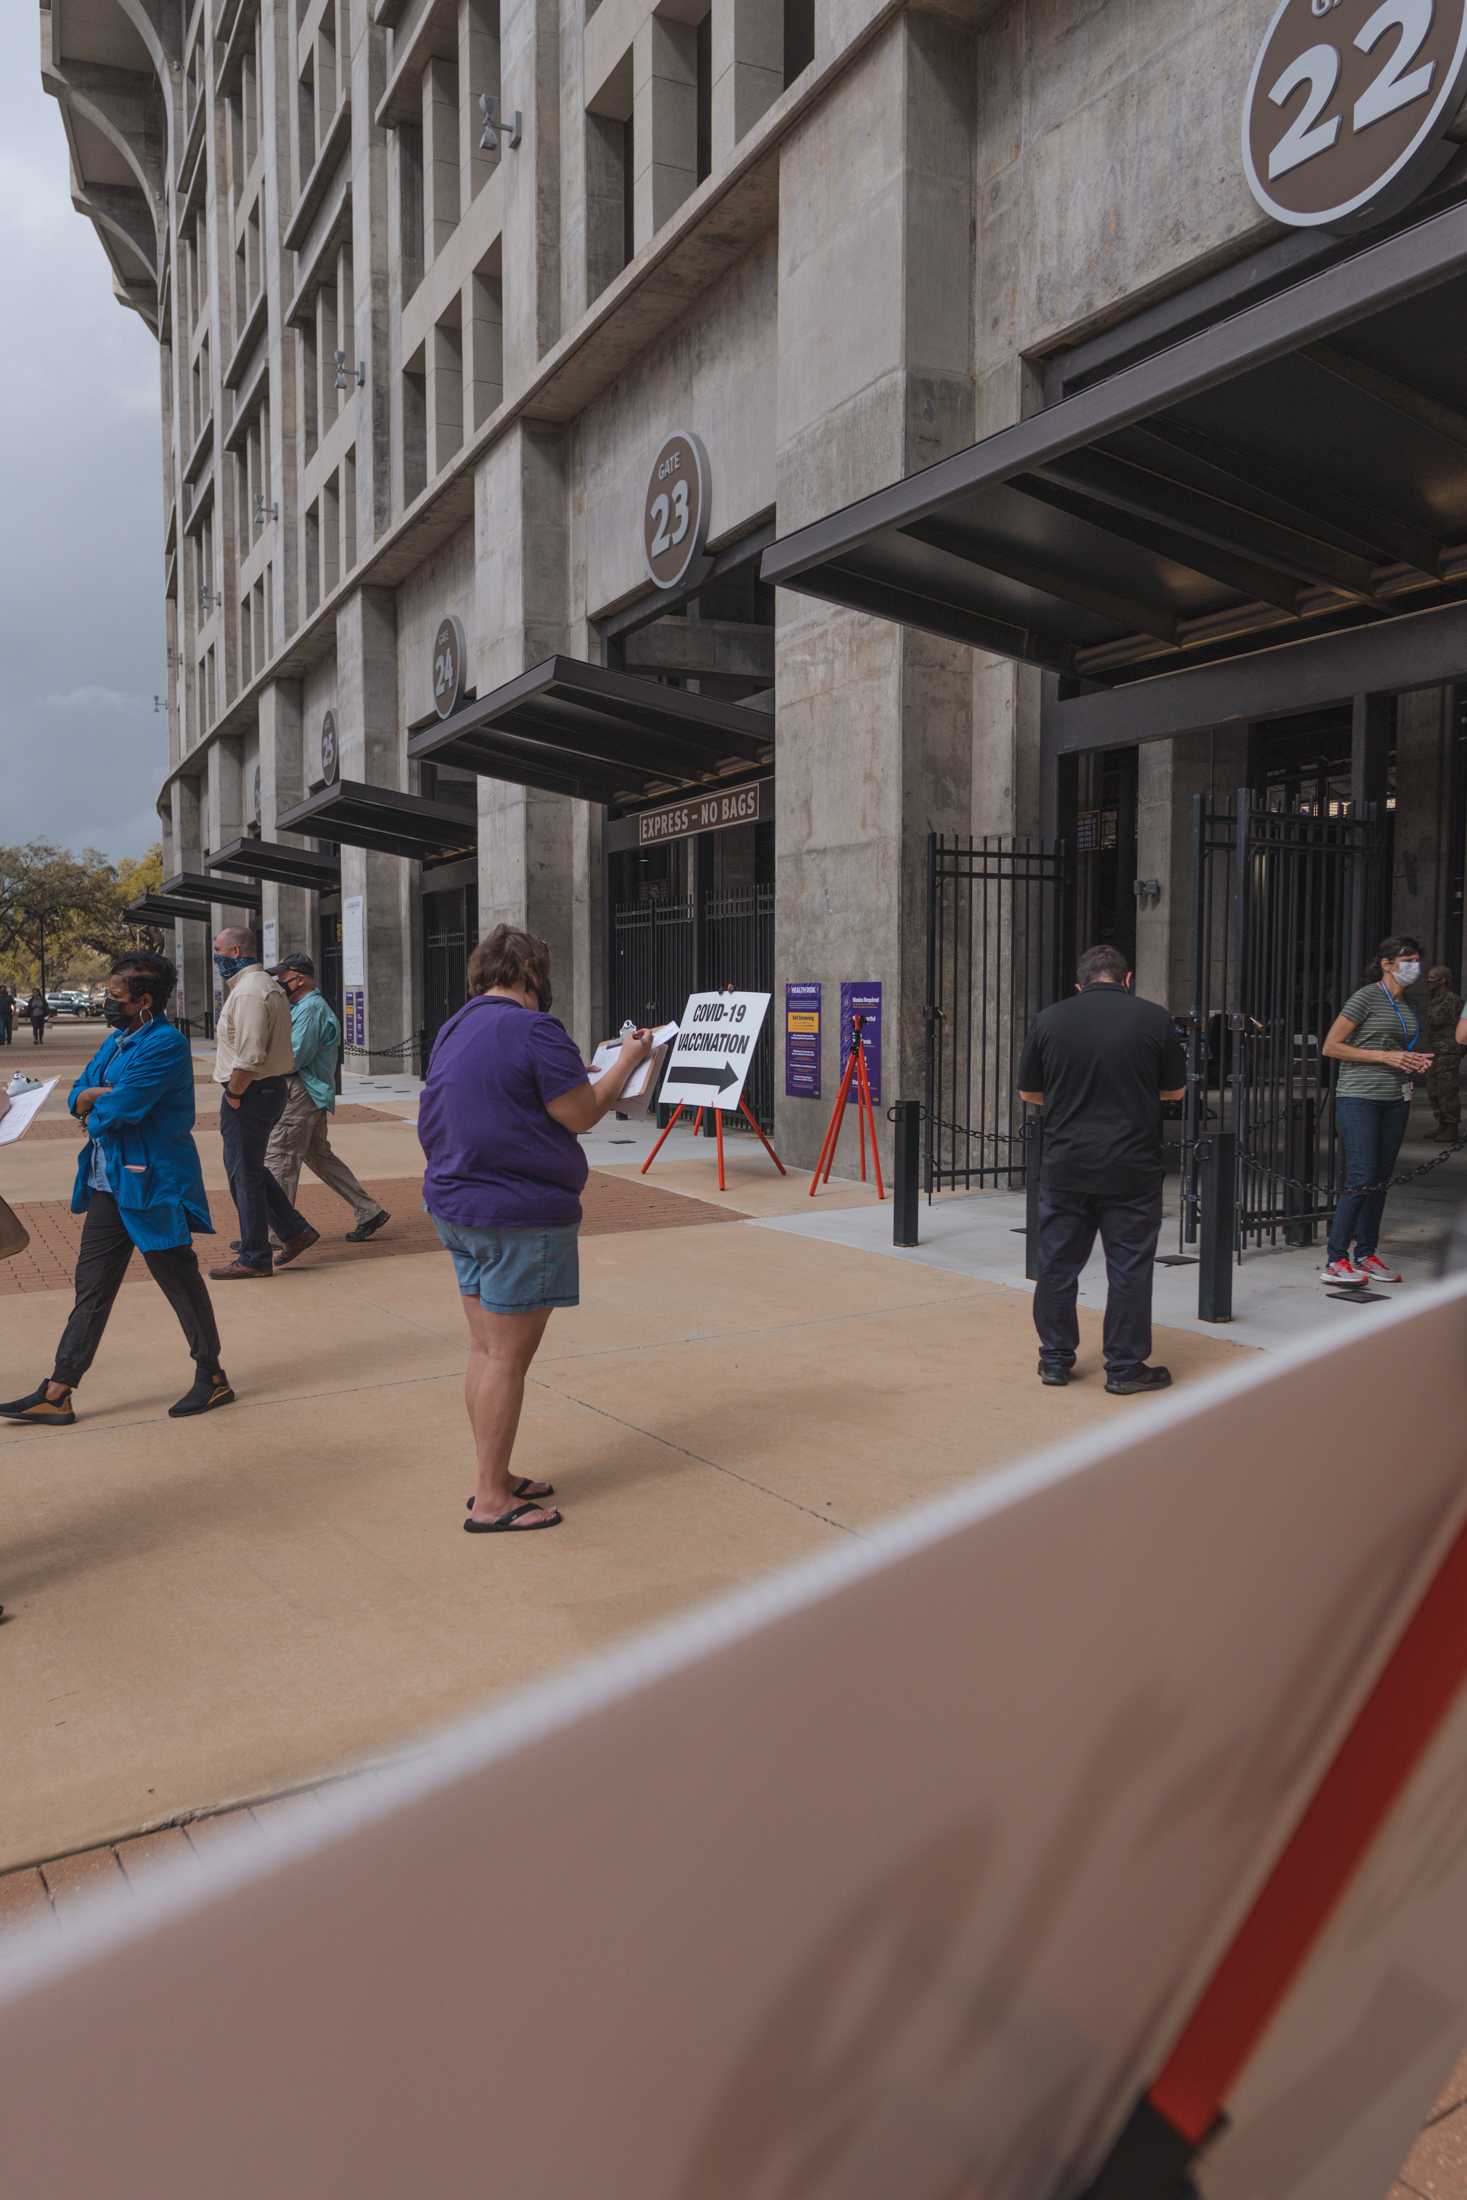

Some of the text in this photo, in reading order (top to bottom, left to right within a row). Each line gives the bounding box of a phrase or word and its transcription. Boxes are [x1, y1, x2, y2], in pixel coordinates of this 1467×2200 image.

[1268, 0, 1437, 182] 22
[658, 452, 681, 480] GATE
[650, 480, 689, 559] 23
[435, 648, 454, 697] 24
[642, 809, 689, 839] EXPRESS
[701, 801, 718, 825] NO
[722, 792, 755, 820] BAGS
[693, 1003, 747, 1023] COVID-19
[677, 1032, 750, 1054] VACCINATION
